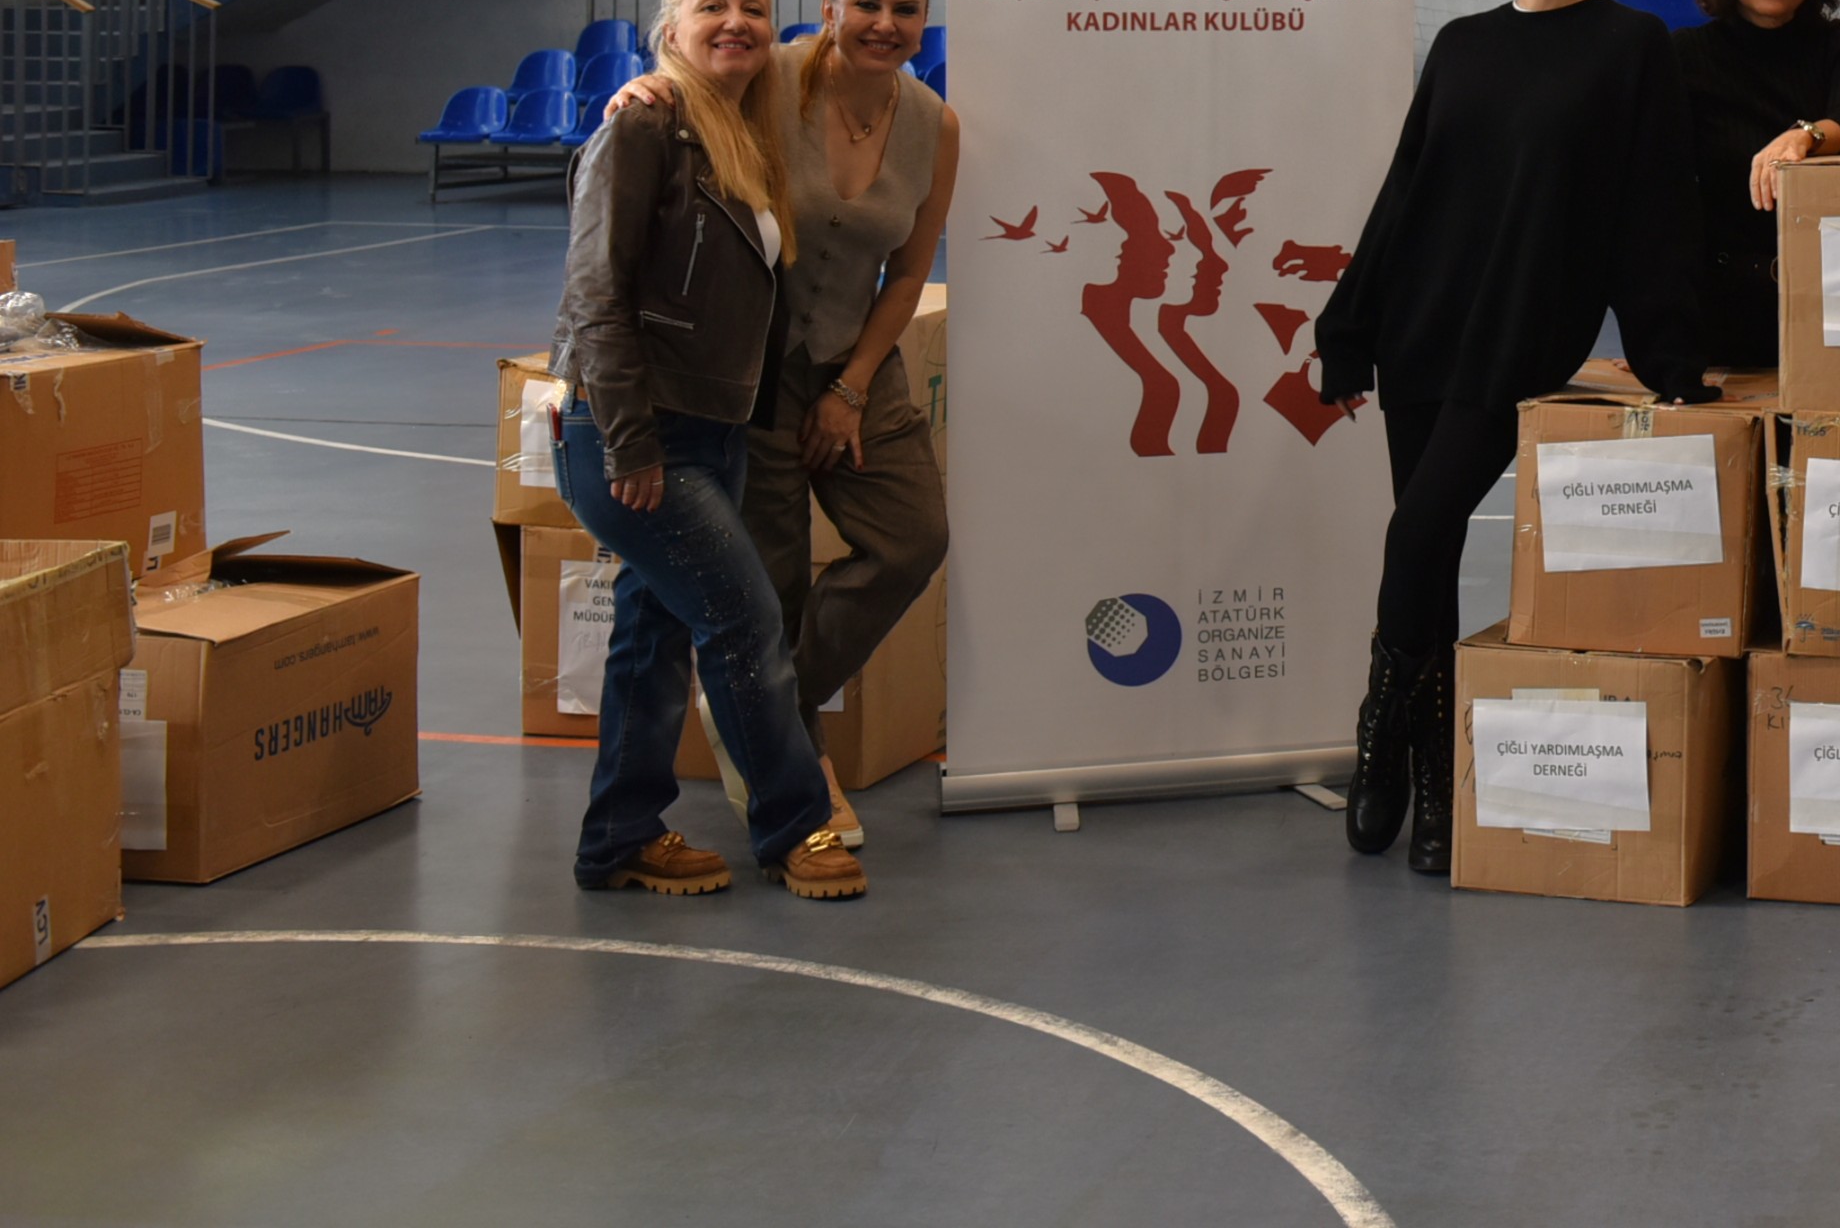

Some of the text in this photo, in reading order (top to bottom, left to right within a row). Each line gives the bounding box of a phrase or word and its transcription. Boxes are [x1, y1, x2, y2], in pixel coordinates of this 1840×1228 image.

[1066, 10, 1305, 33] KADINLAR KULÜBÜ
[1562, 479, 1694, 500] ÇİĞLİ YARDIMLAŞMA
[1600, 500, 1657, 516] DERNEĞİ
[1198, 585, 1285, 606] İZMİR
[1197, 605, 1285, 625] ATATÜRK
[1197, 624, 1286, 644] ORGANİZE
[274, 626, 380, 670] www.tamhangers.com
[1197, 642, 1286, 663] SANAYİ
[1197, 664, 1286, 683] BÖLGESİ
[254, 700, 343, 761] HANGERS
[1497, 740, 1624, 759] ÇİĞLİ YARDIMLAŞMA
[1533, 762, 1588, 777] DERNEĞİ
